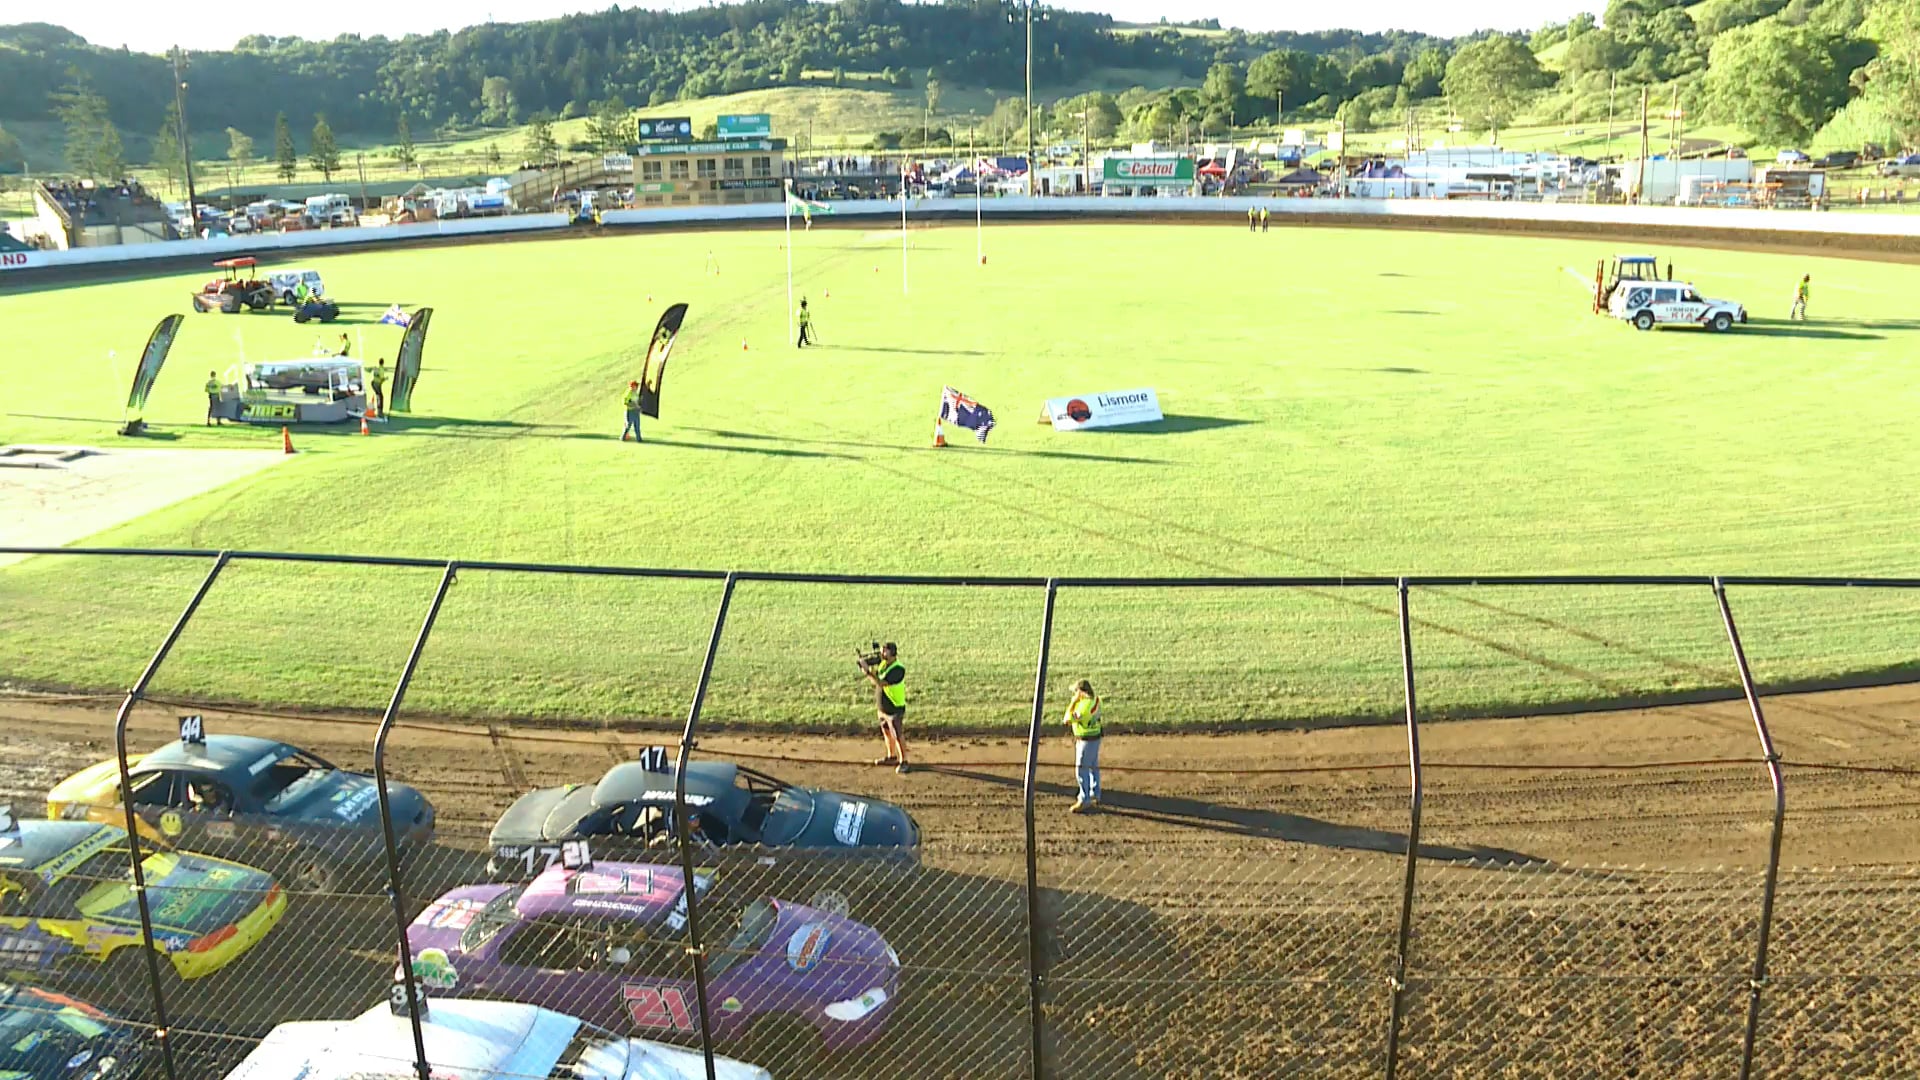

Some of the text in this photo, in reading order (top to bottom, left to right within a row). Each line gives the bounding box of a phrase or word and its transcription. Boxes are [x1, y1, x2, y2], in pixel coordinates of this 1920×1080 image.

[1131, 162, 1173, 176] Castrol
[0, 253, 28, 265] ND
[1670, 311, 1694, 320] KIA
[1097, 392, 1149, 409] Lismore
[181, 715, 201, 744] 44
[640, 745, 665, 770] 17
[520, 845, 561, 876] 17
[562, 840, 591, 867] 21
[620, 983, 697, 1034] 21
